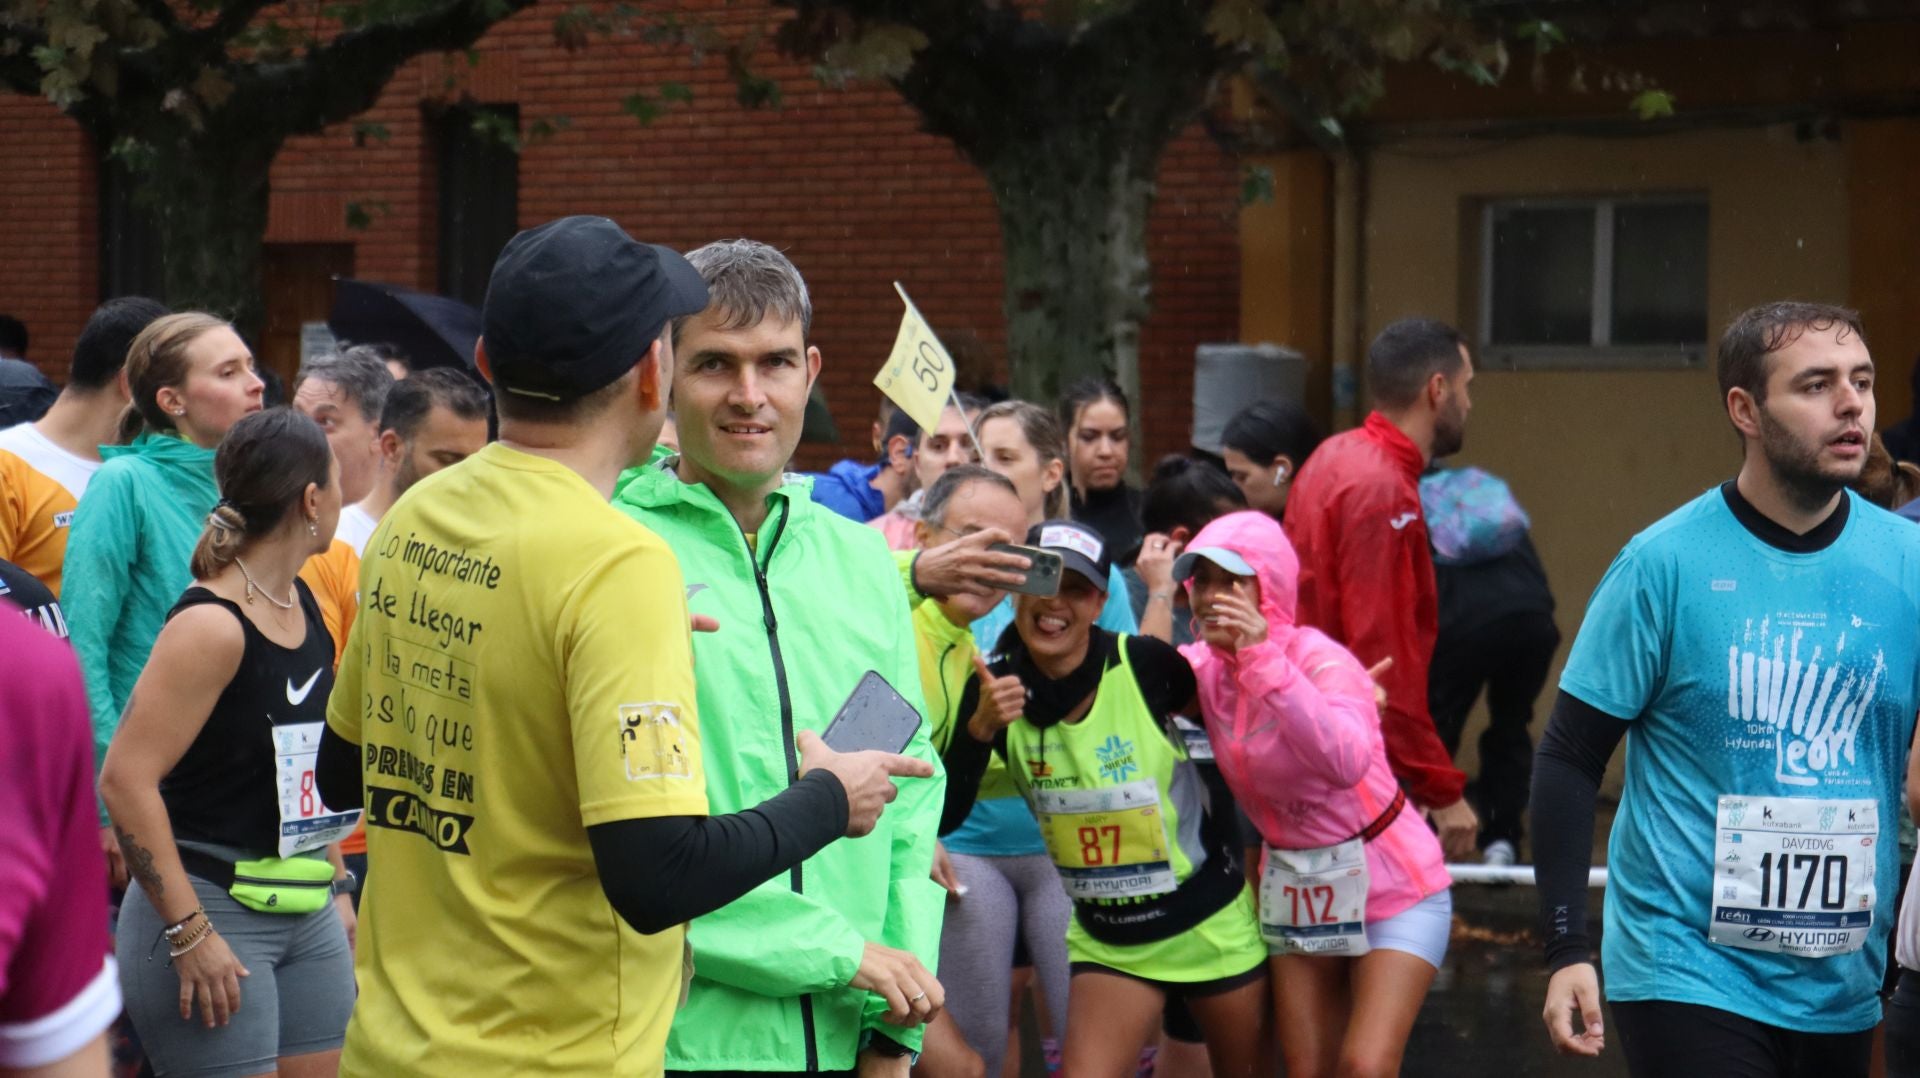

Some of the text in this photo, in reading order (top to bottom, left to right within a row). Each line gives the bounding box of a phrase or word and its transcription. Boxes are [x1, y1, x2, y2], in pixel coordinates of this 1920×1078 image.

[912, 341, 944, 392] 50
[380, 521, 501, 589] Lo importante
[369, 577, 482, 649] de llegar
[386, 639, 401, 675] la
[412, 660, 471, 698] meta
[401, 687, 416, 734] lo
[426, 714, 473, 757] que
[1746, 723, 1775, 735] 10km
[441, 768, 475, 803] EN
[1762, 820, 1803, 829] kutxabank
[1763, 805, 1773, 820] k
[1848, 808, 1857, 822] k
[1077, 824, 1121, 866] 87
[1782, 837, 1834, 850] DAVIDVG
[1092, 876, 1152, 891] HYUNDAI
[1759, 852, 1848, 910] 1170
[1283, 884, 1339, 928] 712
[1780, 931, 1850, 945] HYUNDAI
